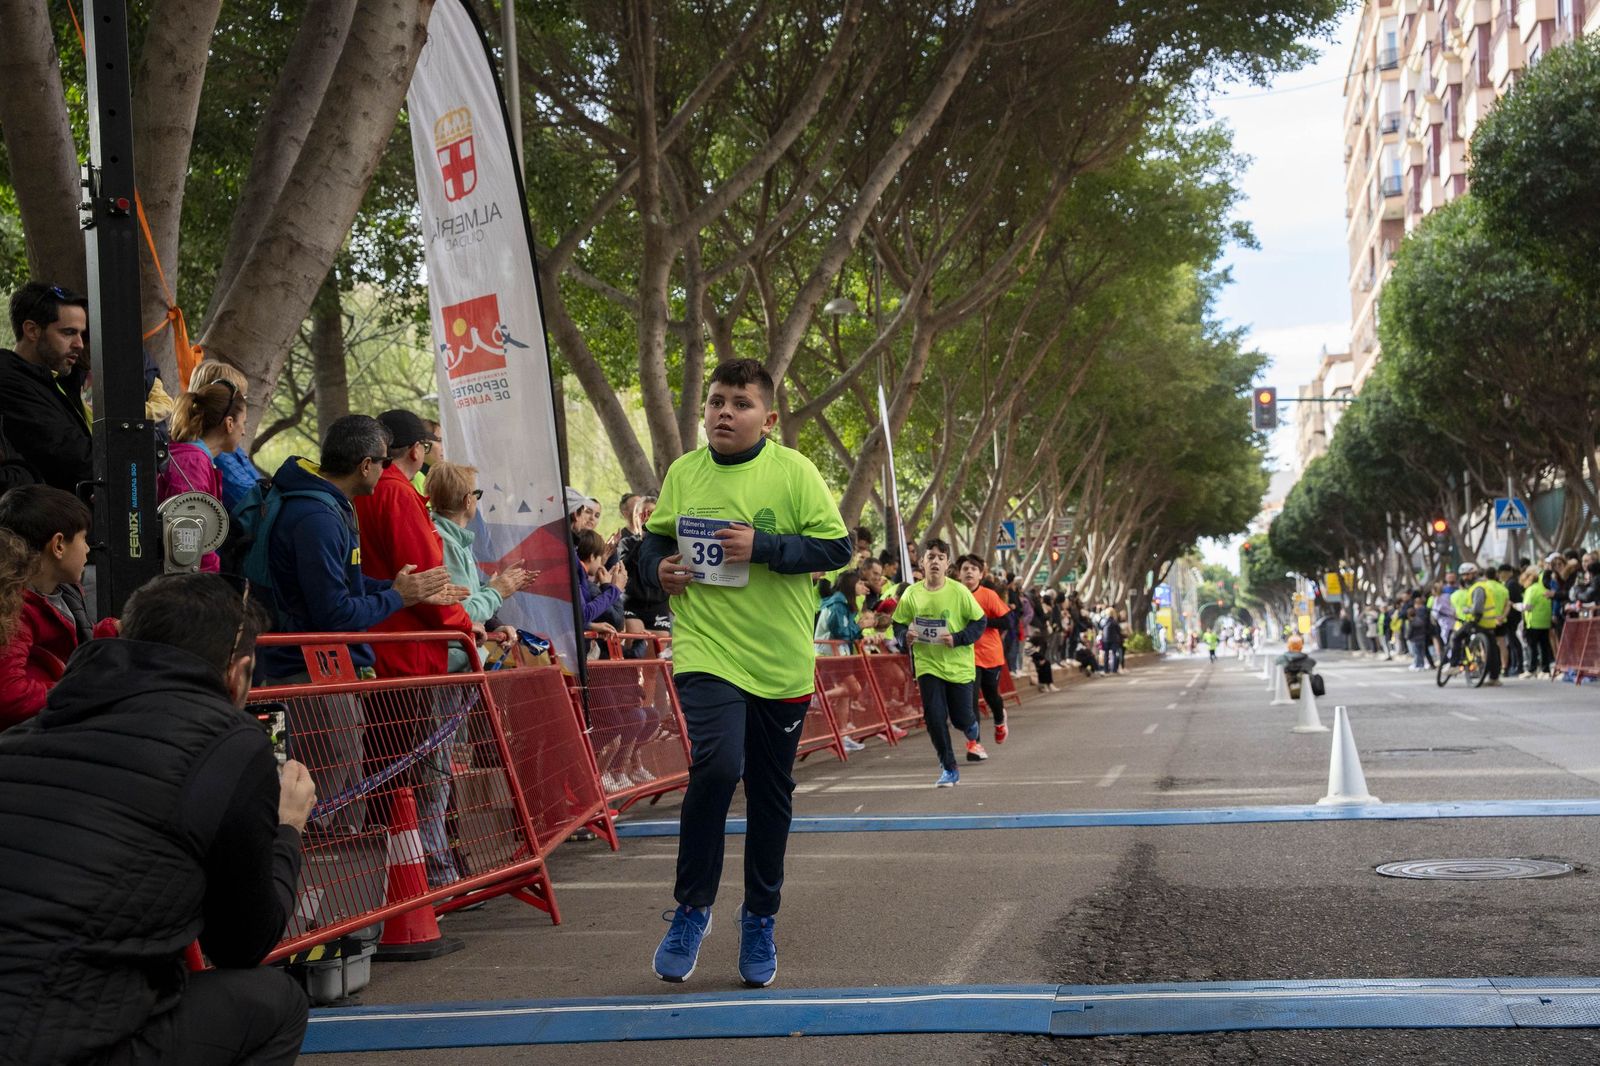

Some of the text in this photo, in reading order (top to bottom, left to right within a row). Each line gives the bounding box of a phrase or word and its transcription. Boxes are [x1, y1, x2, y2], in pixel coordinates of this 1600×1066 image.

[129, 512, 140, 558] FENIX
[691, 541, 724, 567] 39
[922, 627, 938, 638] 45
